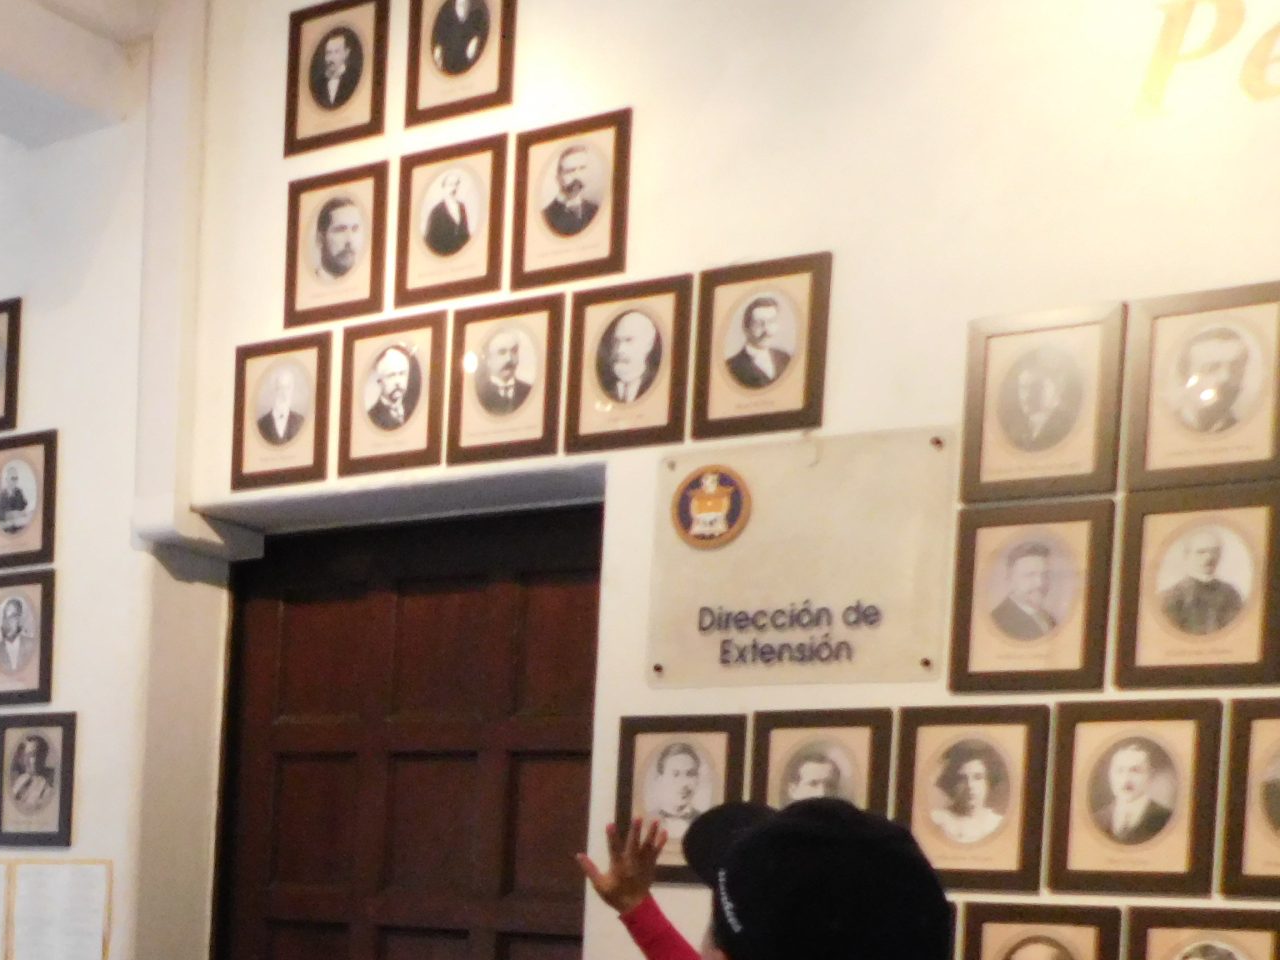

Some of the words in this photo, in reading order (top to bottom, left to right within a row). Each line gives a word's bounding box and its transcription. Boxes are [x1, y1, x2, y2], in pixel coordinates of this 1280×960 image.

[697, 599, 832, 632] Dirección
[842, 601, 881, 627] de
[719, 633, 852, 665] Extensión
